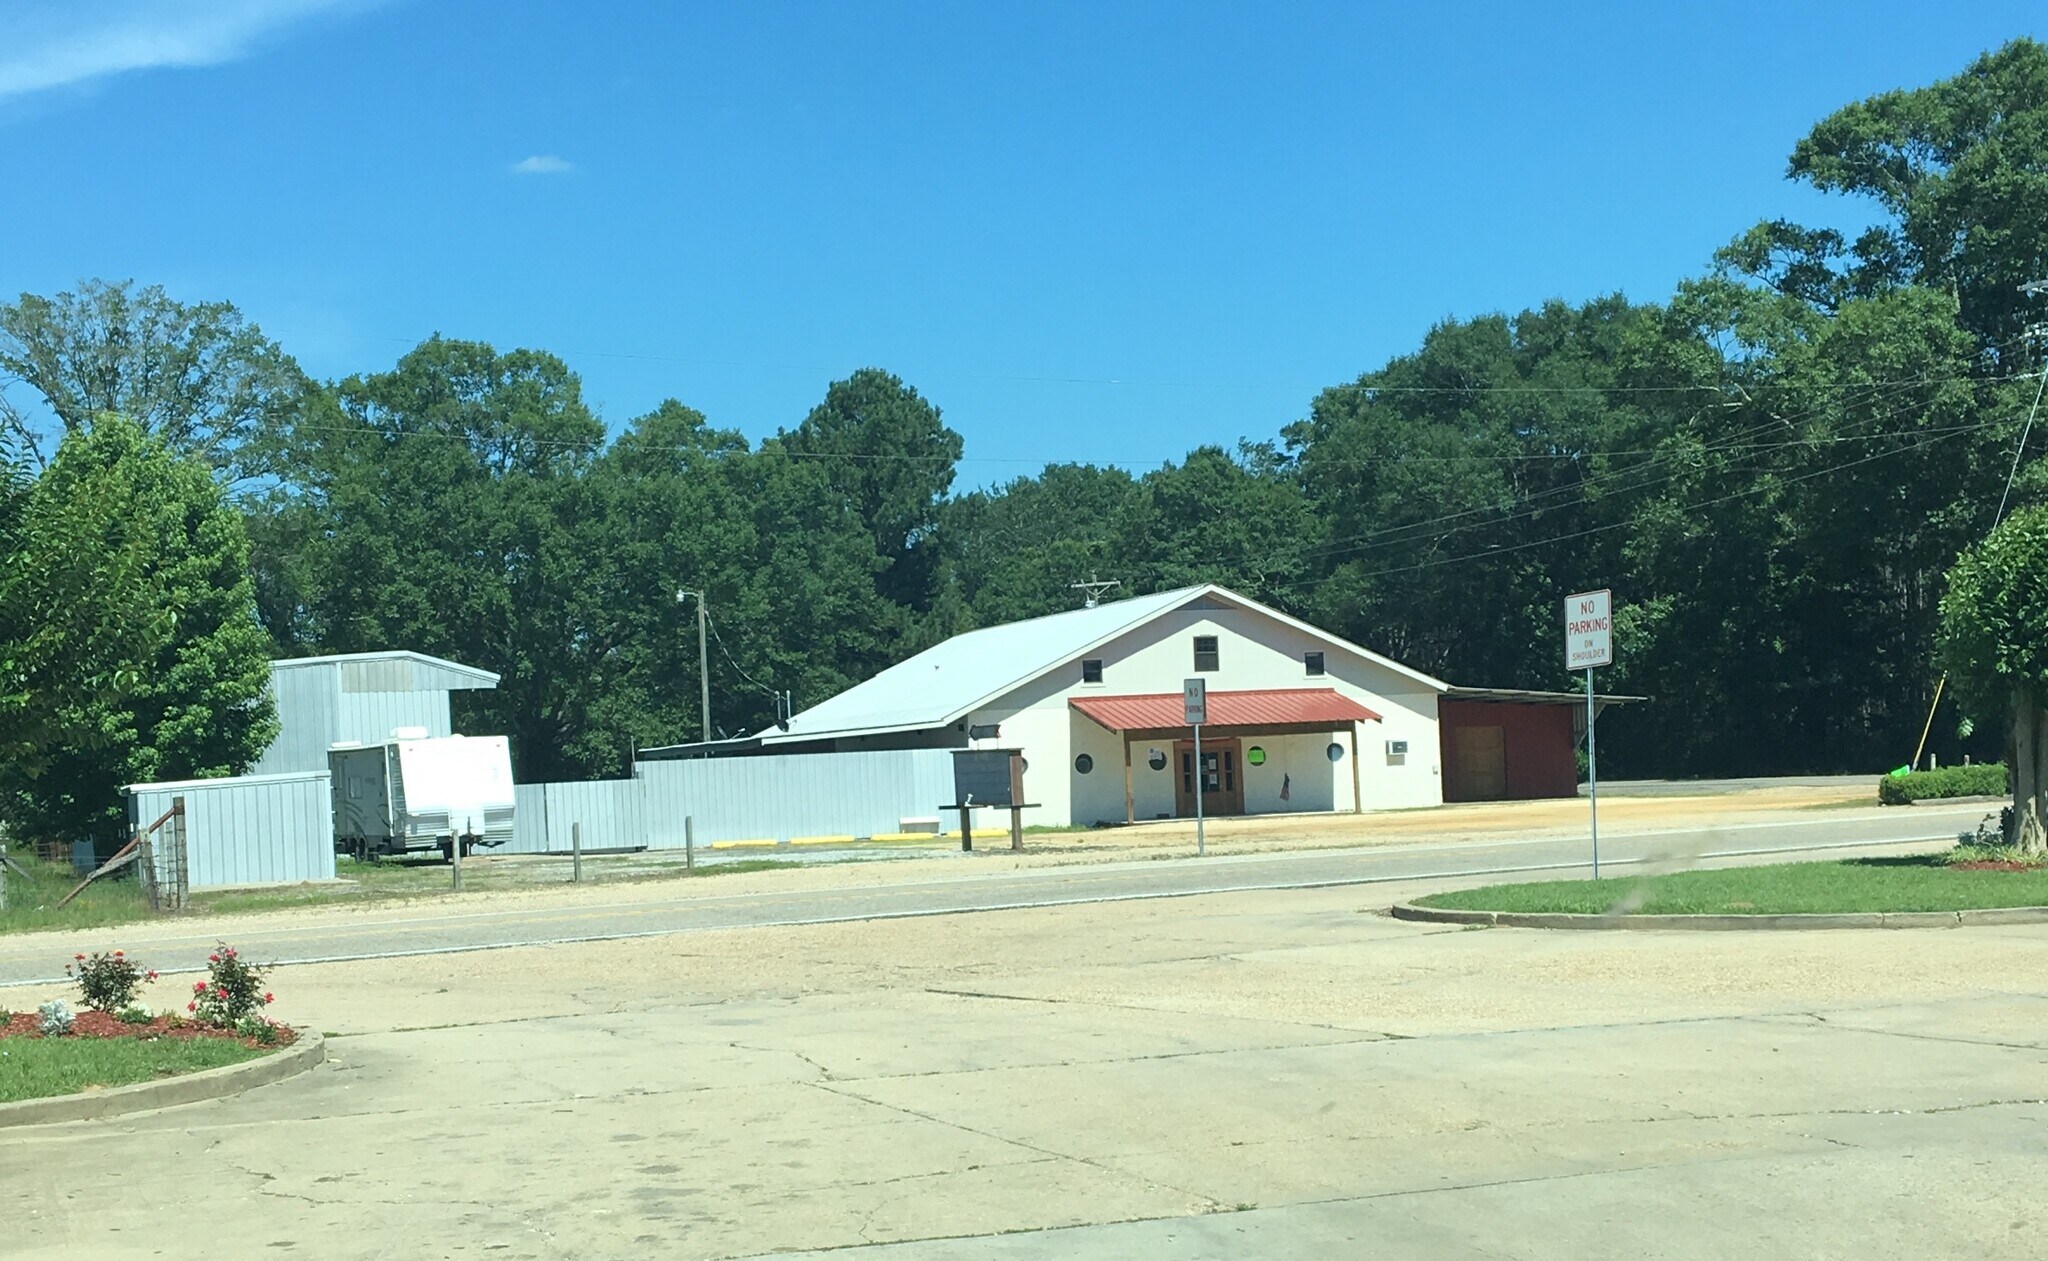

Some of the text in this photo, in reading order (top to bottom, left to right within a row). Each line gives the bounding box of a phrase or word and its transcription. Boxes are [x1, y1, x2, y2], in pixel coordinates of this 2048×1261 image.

[1581, 600, 1595, 615] NO
[1569, 617, 1608, 635] PARKING
[1584, 639, 1593, 648] ON
[1572, 648, 1605, 660] SHOULDER
[1189, 687, 1199, 698] NO
